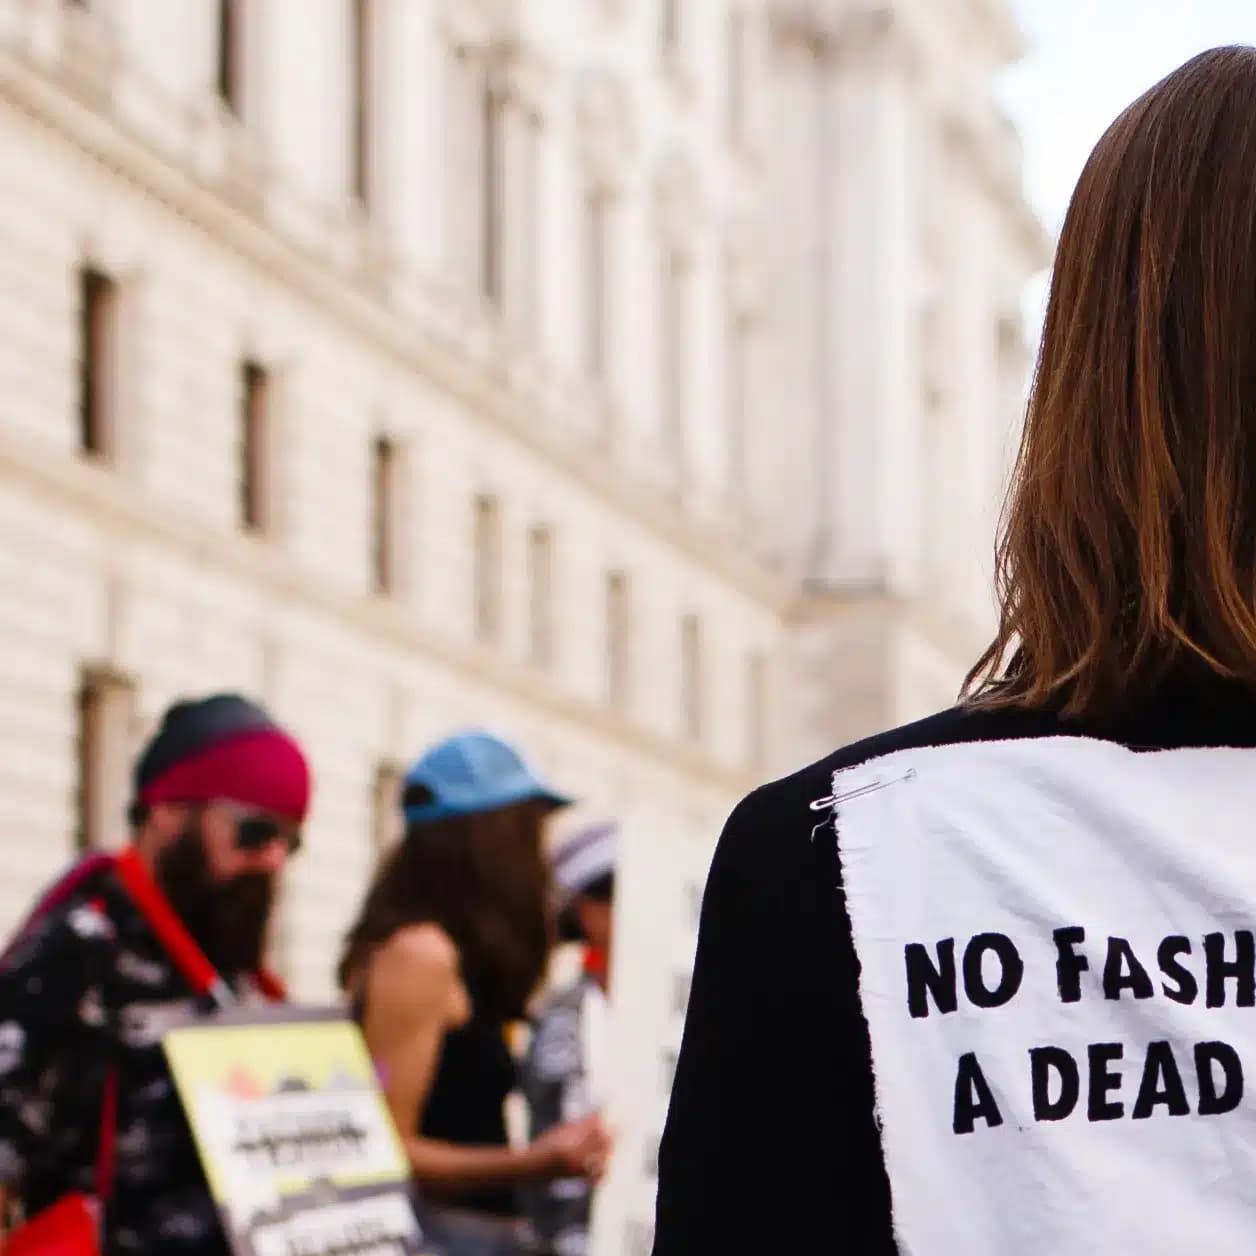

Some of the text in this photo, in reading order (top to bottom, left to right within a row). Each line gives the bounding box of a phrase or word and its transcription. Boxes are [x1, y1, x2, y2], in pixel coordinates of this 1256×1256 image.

[904, 931, 1024, 1019] NO
[952, 1051, 1004, 1135] A
[1027, 1039, 1245, 1122] DEAD
